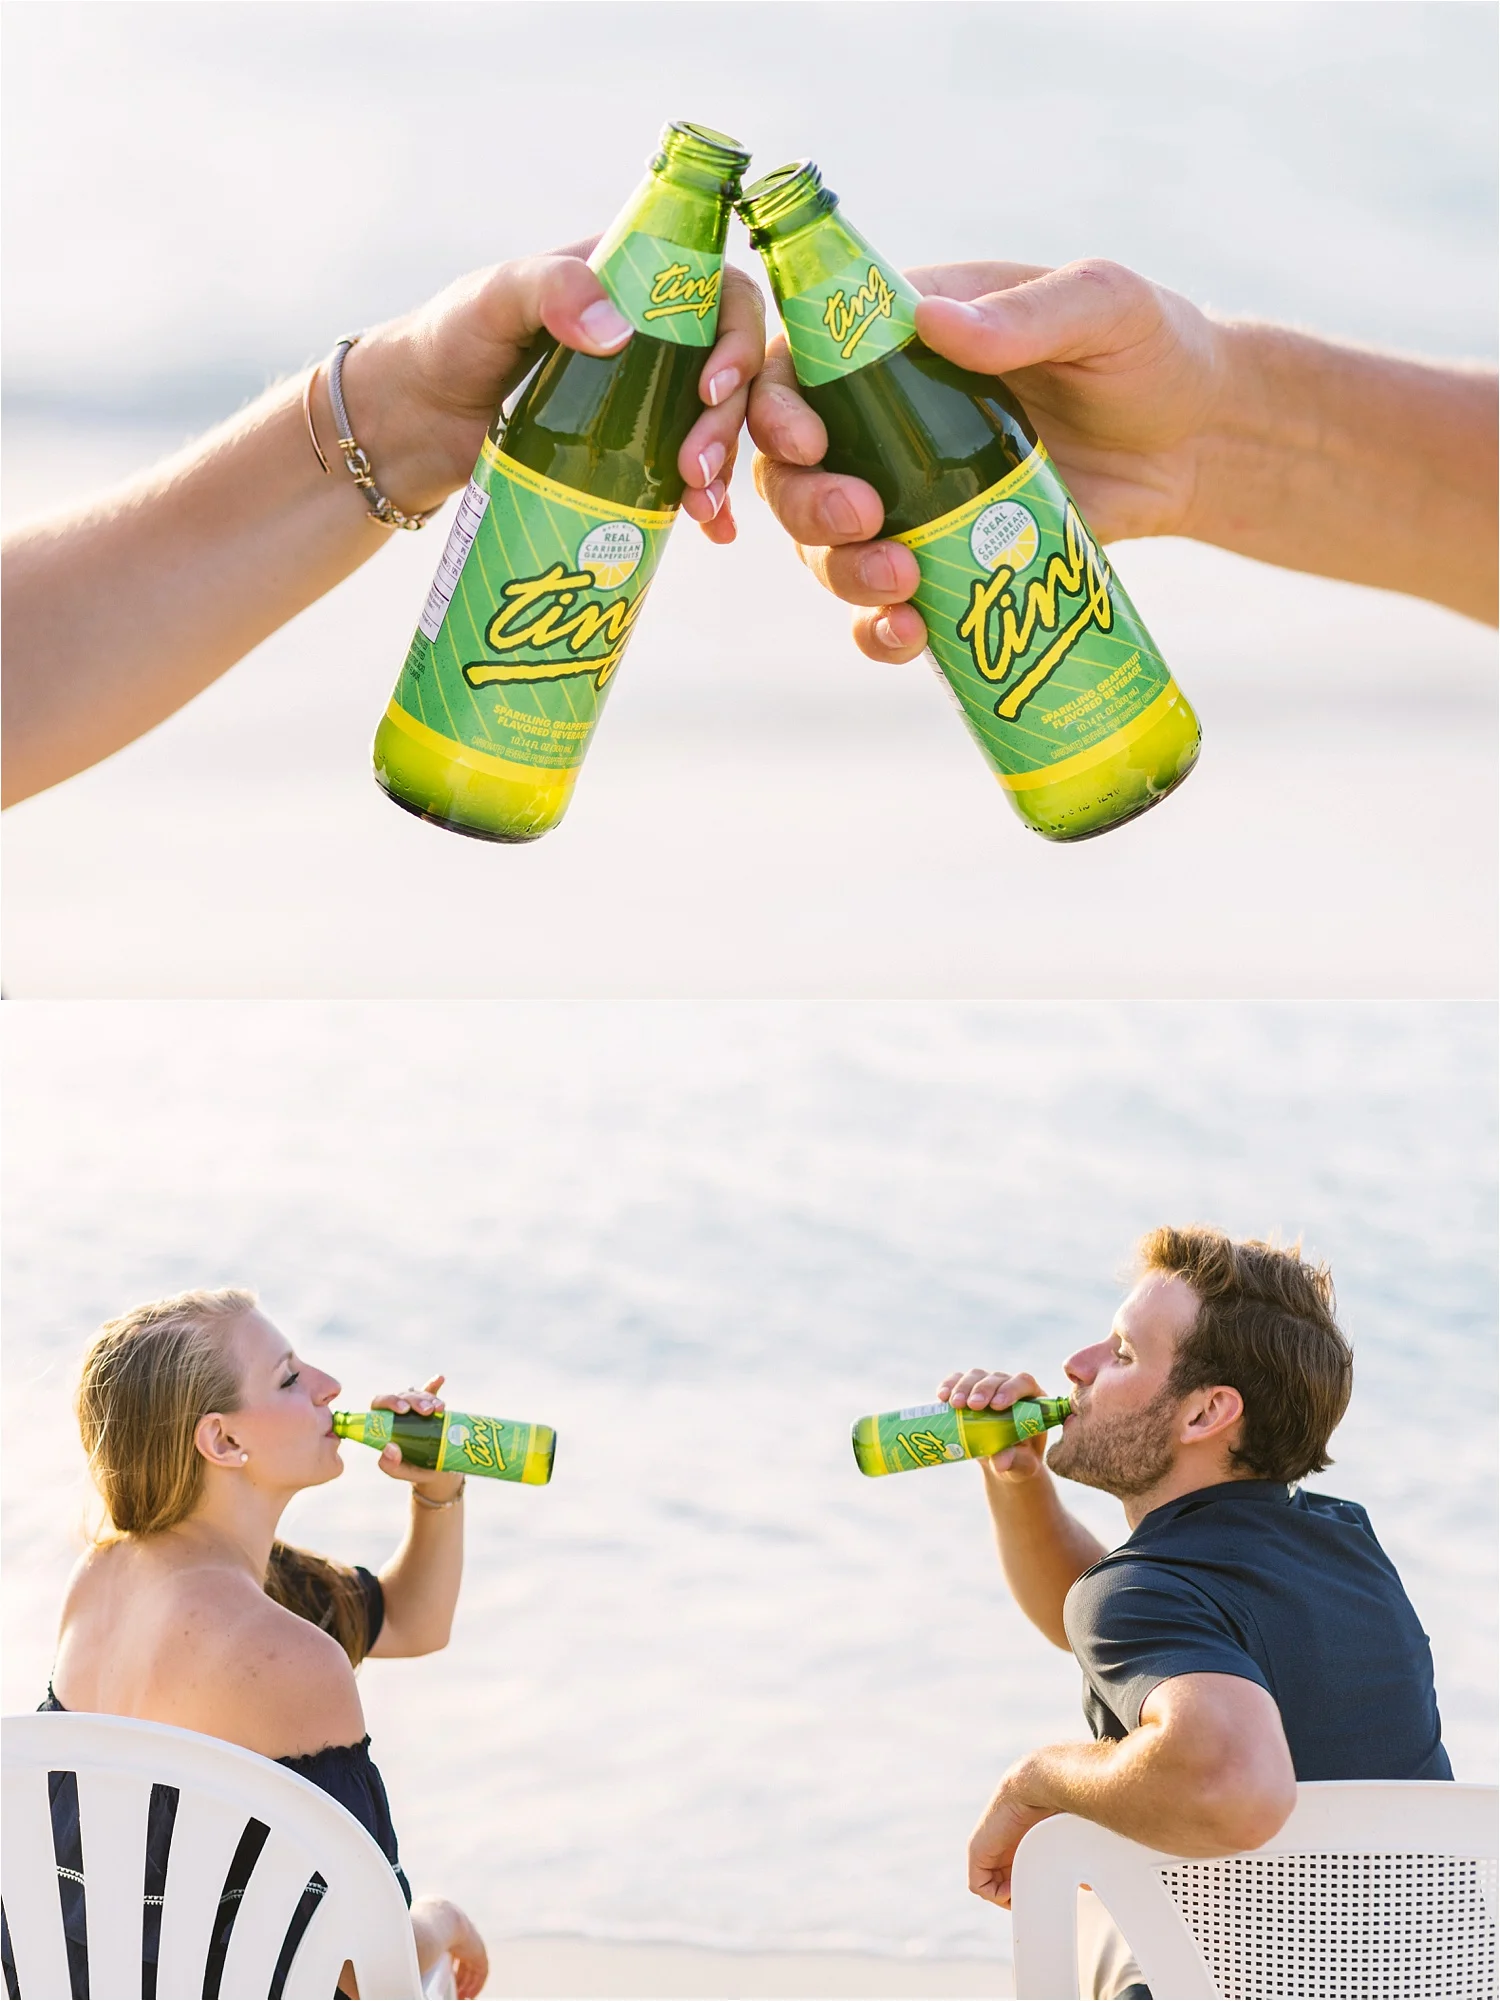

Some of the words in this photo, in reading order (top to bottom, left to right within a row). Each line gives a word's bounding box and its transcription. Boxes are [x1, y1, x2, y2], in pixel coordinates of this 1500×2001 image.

[644, 263, 721, 320] ting
[823, 263, 897, 359] ting
[604, 533, 631, 543] REAL
[913, 535, 926, 544] THE
[927, 519, 960, 538] JAMAICAN
[978, 510, 1024, 555] CARIBBEAN
[982, 512, 1008, 536] REAL
[983, 516, 1028, 561] GRAPEFRUITS
[584, 551, 639, 560] GRAPEFRUITS
[585, 544, 641, 553] CARIBBEAN
[462, 561, 655, 691] ting
[956, 498, 1113, 722] ting
[1041, 689, 1096, 724] SPARKLING
[1096, 651, 1141, 693] GRAPEFRUIT
[1052, 695, 1103, 729] FLAVORED
[1102, 663, 1142, 700] BEVERAGE
[493, 704, 551, 728] SPARKLING
[497, 716, 550, 737] FLAVORED
[1076, 719, 1096, 733] 10.14
[1105, 703, 1116, 716] OZ
[471, 735, 506, 755] CARBONATED
[510, 735, 531, 749] 10.14
[541, 742, 551, 752] OZ
[1051, 739, 1084, 760] CARBONATED
[1081, 724, 1108, 746] BEVERAGE
[463, 1413, 507, 1471] ting
